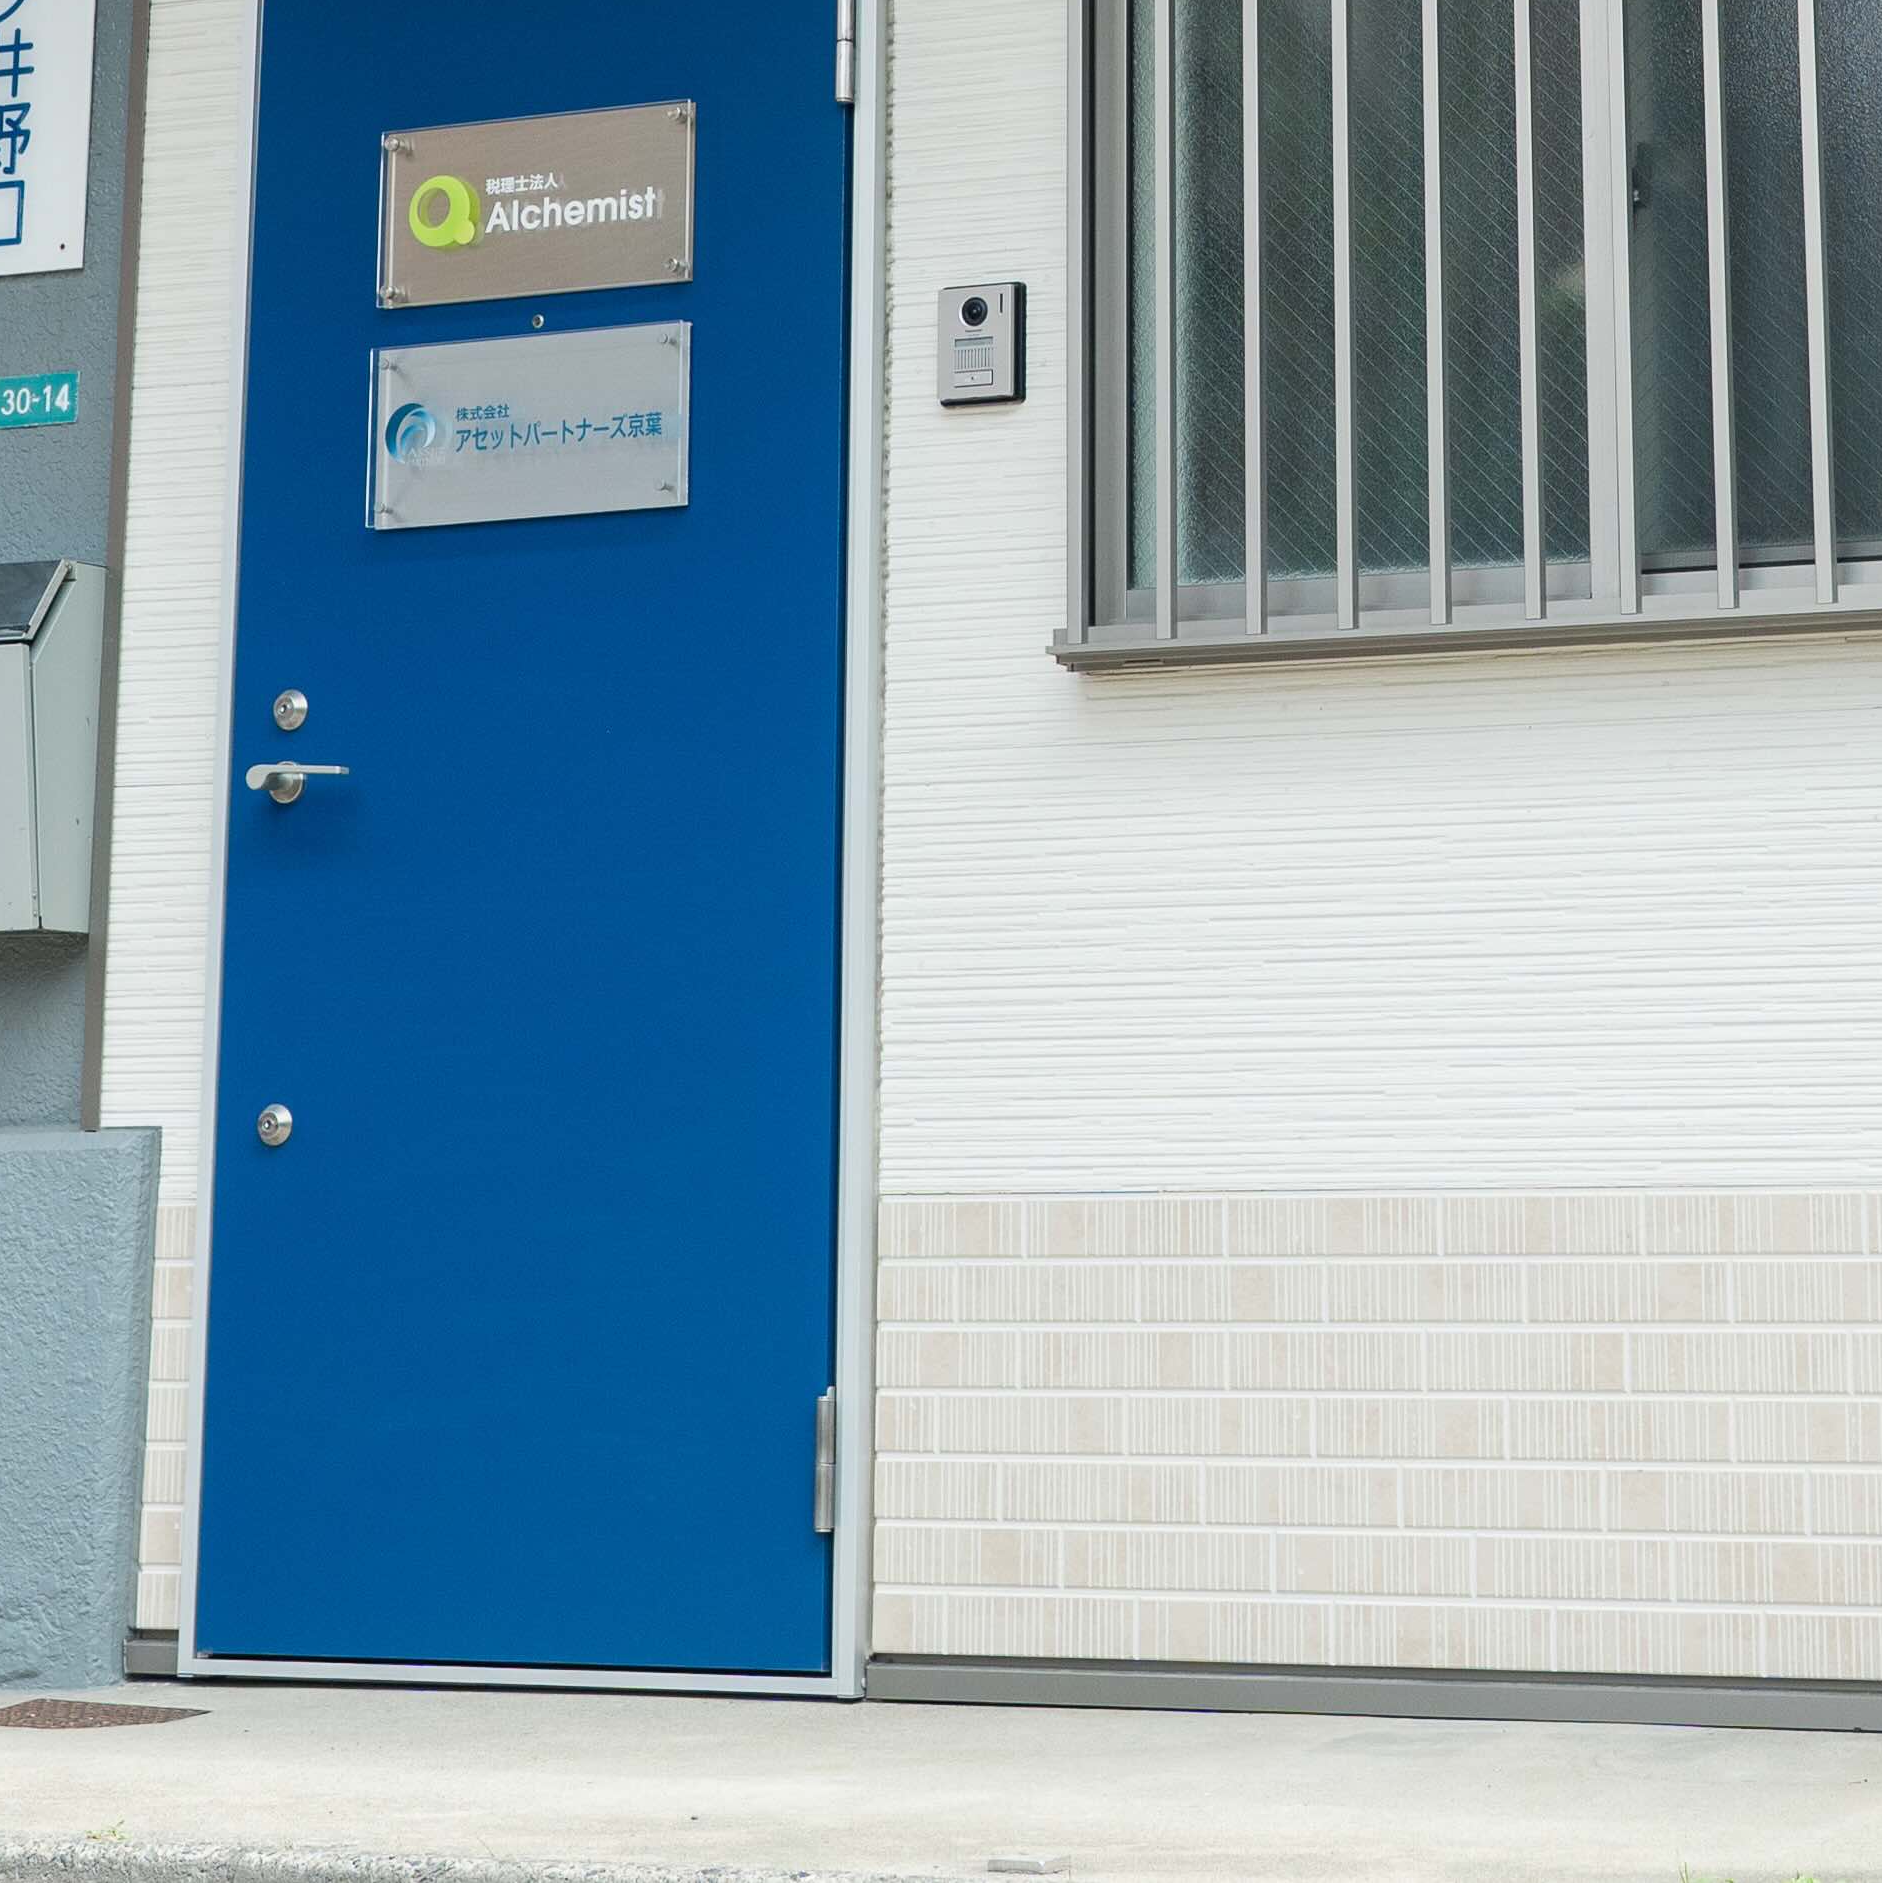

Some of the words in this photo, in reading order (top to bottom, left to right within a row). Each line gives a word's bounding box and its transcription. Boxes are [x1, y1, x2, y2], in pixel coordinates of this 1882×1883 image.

[485, 172, 558, 195] 税理士法人
[485, 186, 657, 234] Alchemist
[0, 383, 70, 416] 30-14
[456, 404, 509, 422] 株式会社
[455, 411, 662, 453] アセットパートナーズ京葉
